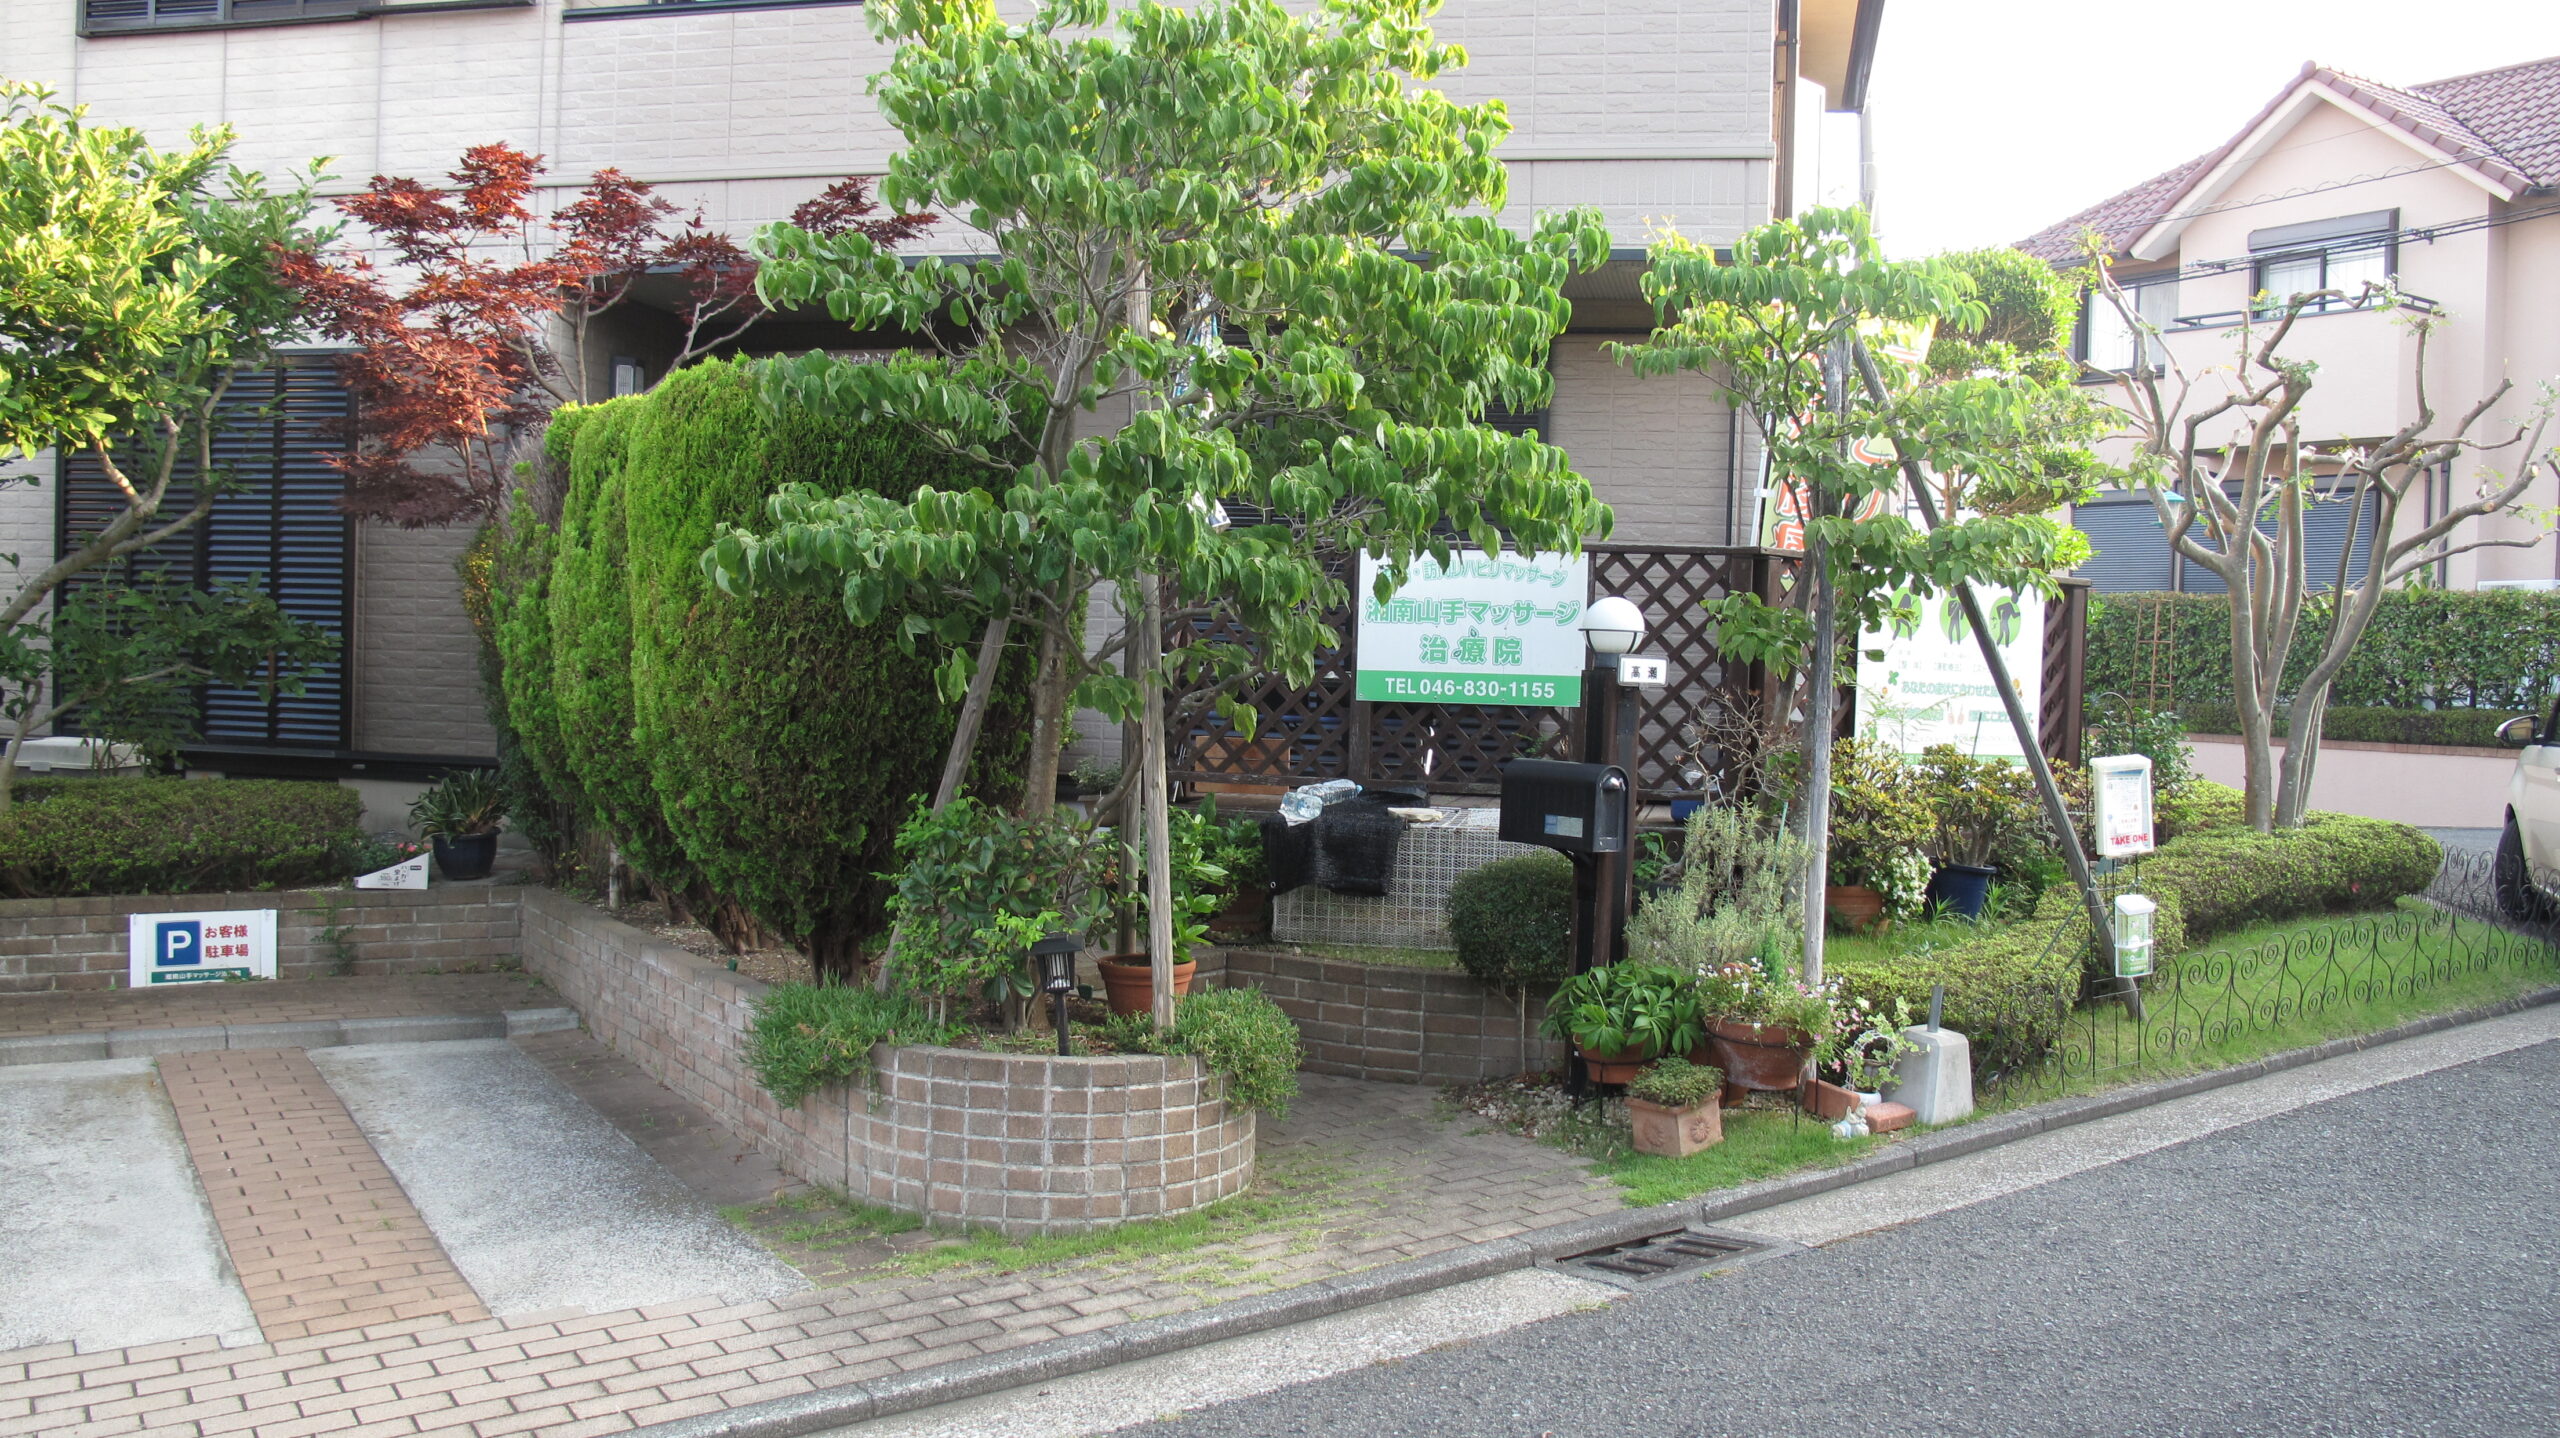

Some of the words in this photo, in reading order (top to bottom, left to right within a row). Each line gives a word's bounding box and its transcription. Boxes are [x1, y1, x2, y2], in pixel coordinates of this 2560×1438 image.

[1366, 597, 1581, 626] 湘南山手マッサージ
[1420, 635, 1522, 665] 治療院
[1385, 678, 1416, 695] TEL
[1420, 679, 1555, 699] 046-830-1155
[2110, 835, 2131, 845] TAKE
[2132, 833, 2148, 844] ONE
[205, 925, 248, 938] お客様
[167, 930, 192, 959] P
[205, 944, 249, 958] 駐車場
